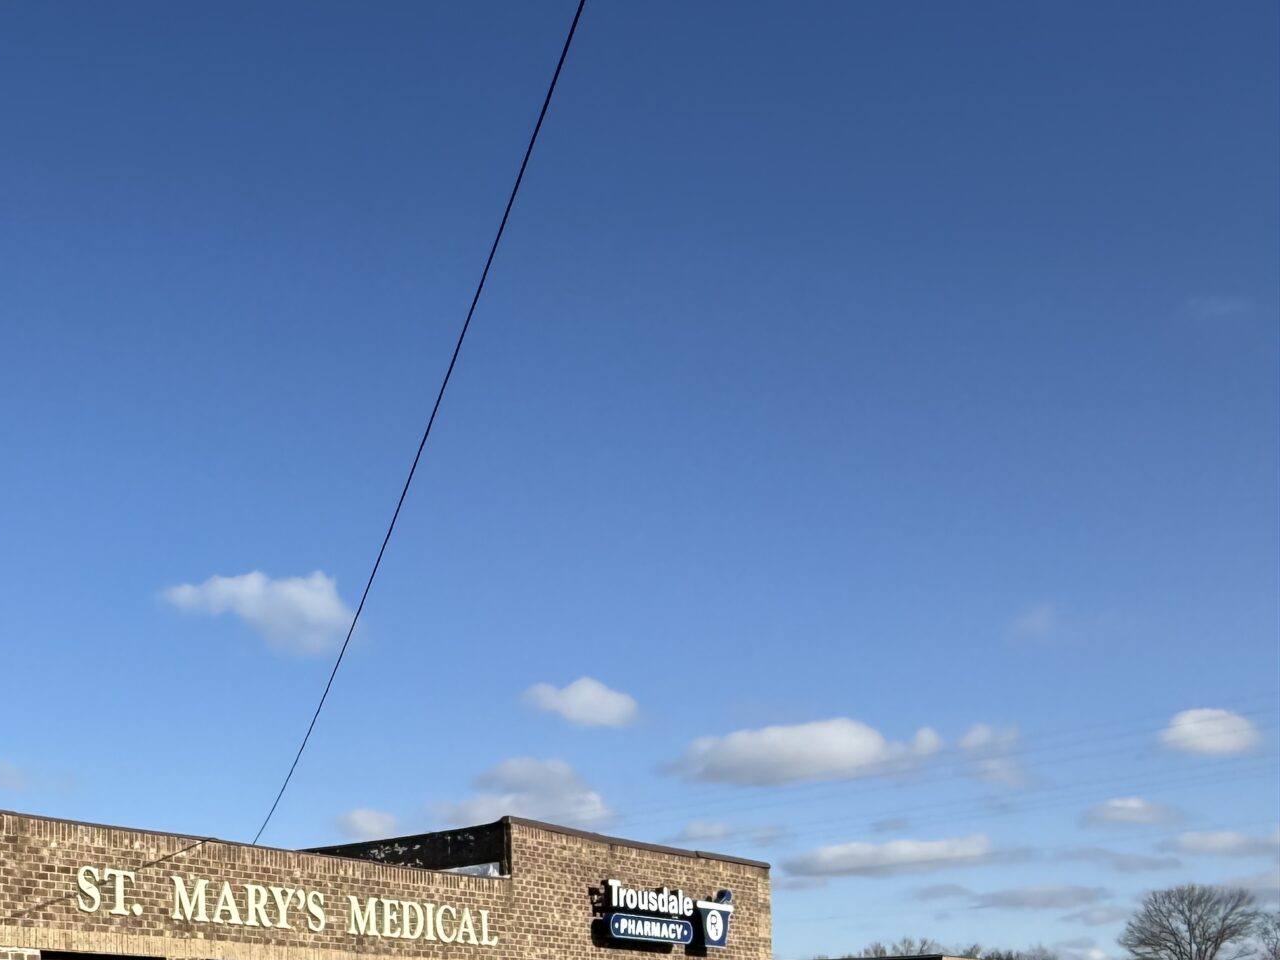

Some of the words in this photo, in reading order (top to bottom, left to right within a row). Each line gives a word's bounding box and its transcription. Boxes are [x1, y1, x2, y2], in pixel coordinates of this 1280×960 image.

[77, 865, 144, 917] ST.
[170, 874, 326, 932] MARY'S
[347, 895, 499, 947] MEDICAL
[608, 879, 694, 917] Trousdale
[620, 918, 683, 939] PHARMACY
